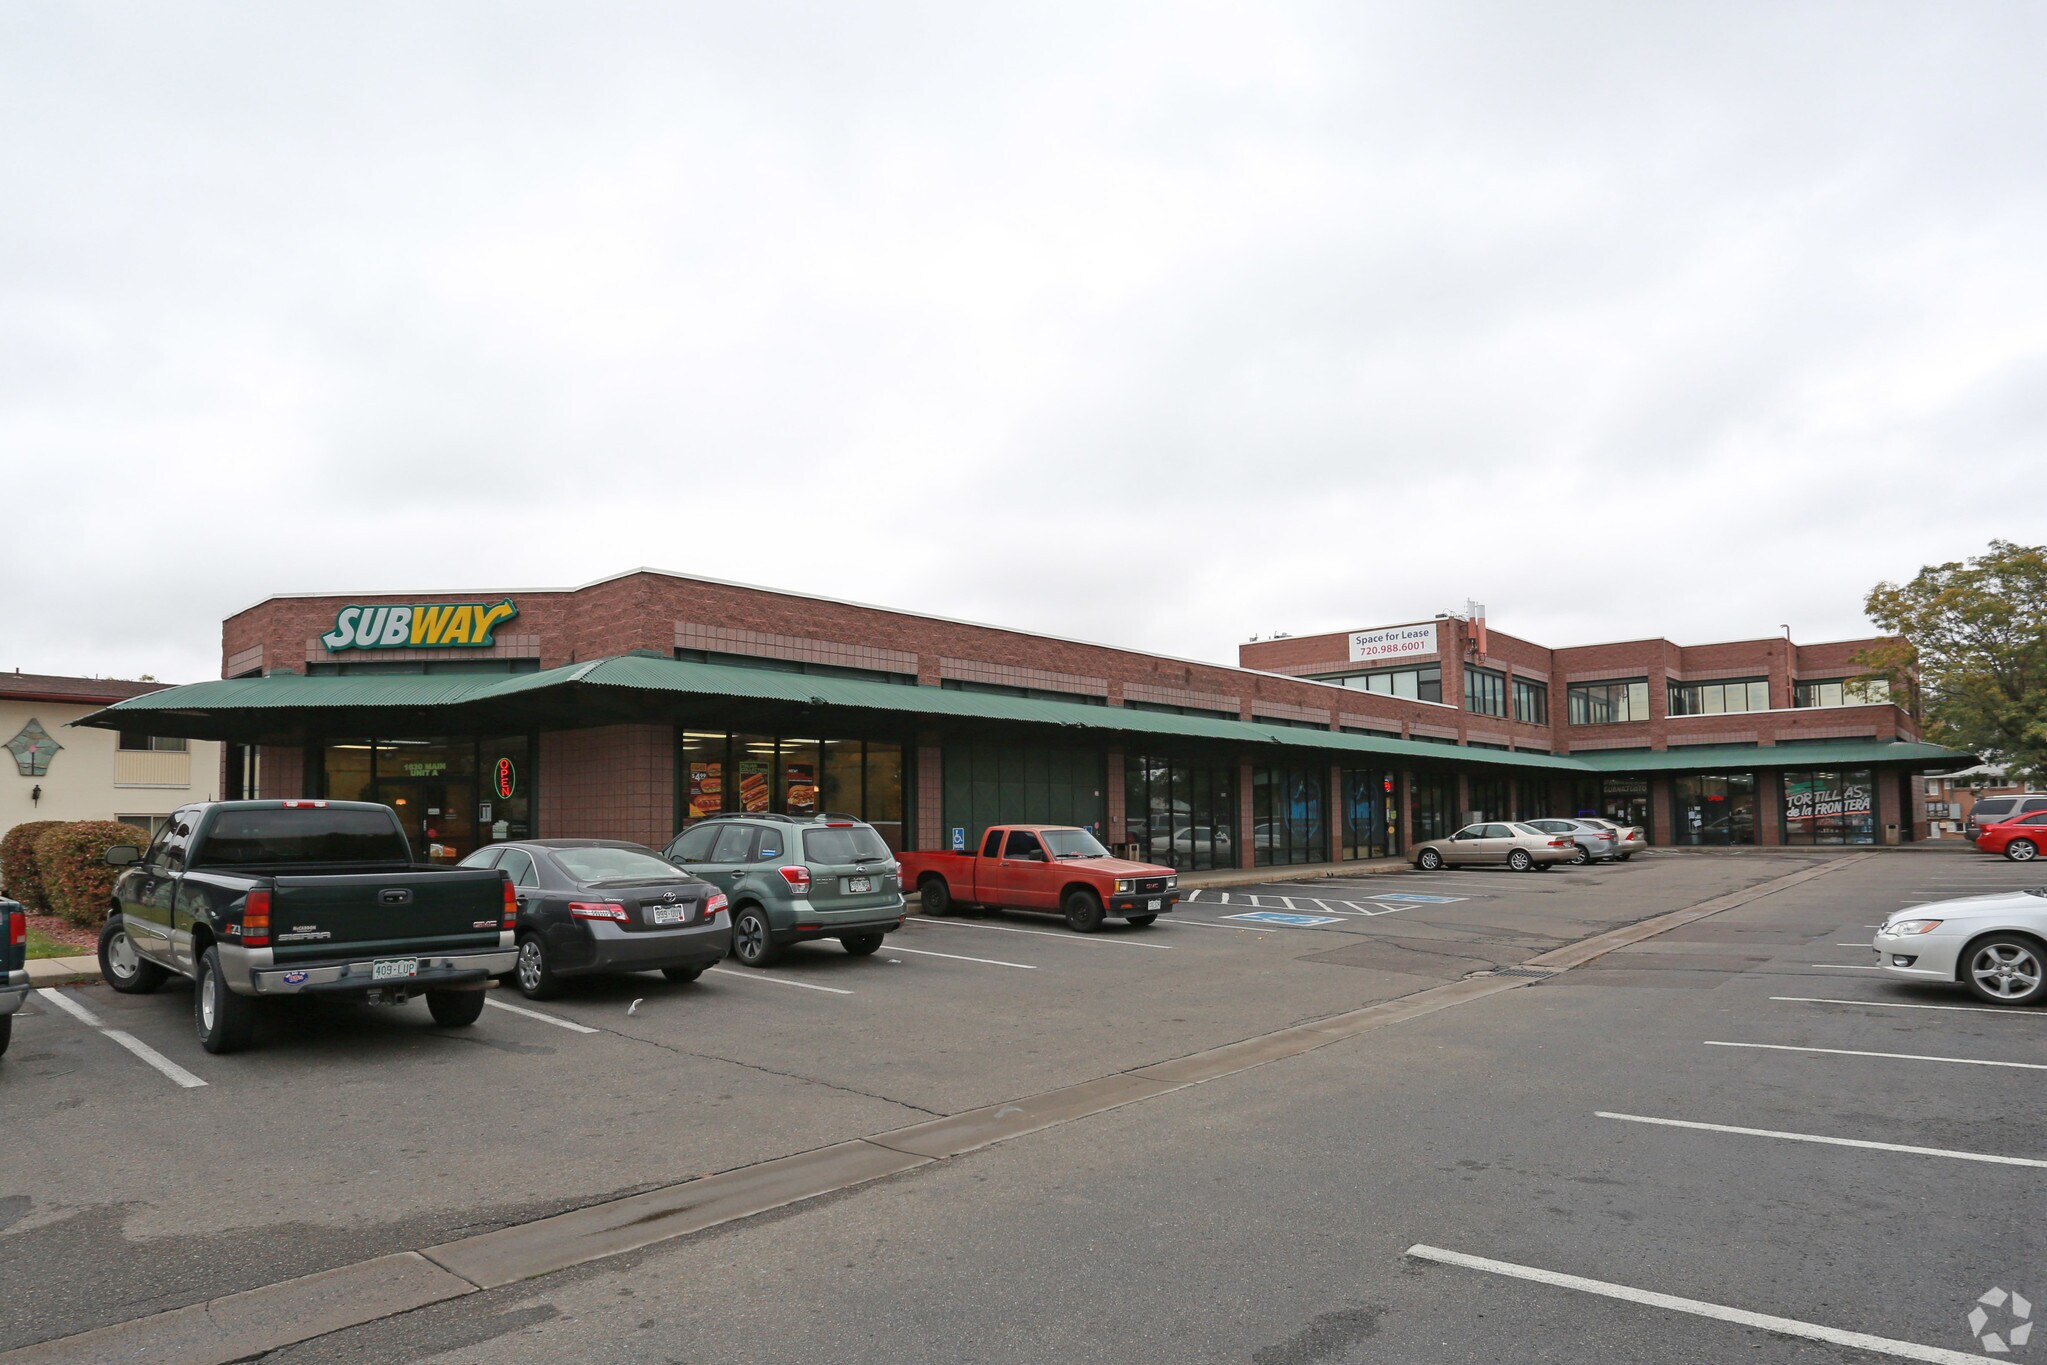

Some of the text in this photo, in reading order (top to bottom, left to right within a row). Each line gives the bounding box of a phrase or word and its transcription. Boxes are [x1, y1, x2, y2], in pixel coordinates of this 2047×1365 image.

[323, 602, 513, 649] SUBWAY
[1356, 629, 1429, 645] Space for Lease
[1360, 641, 1425, 656] 720.988.6001
[499, 759, 510, 797] OPEN
[1786, 807, 1800, 818] de
[1801, 805, 1812, 816] la
[225, 923, 241, 934] Z71
[473, 920, 497, 928] GMC
[278, 931, 331, 941] SIERRA
[376, 963, 415, 976] 409-LUP
